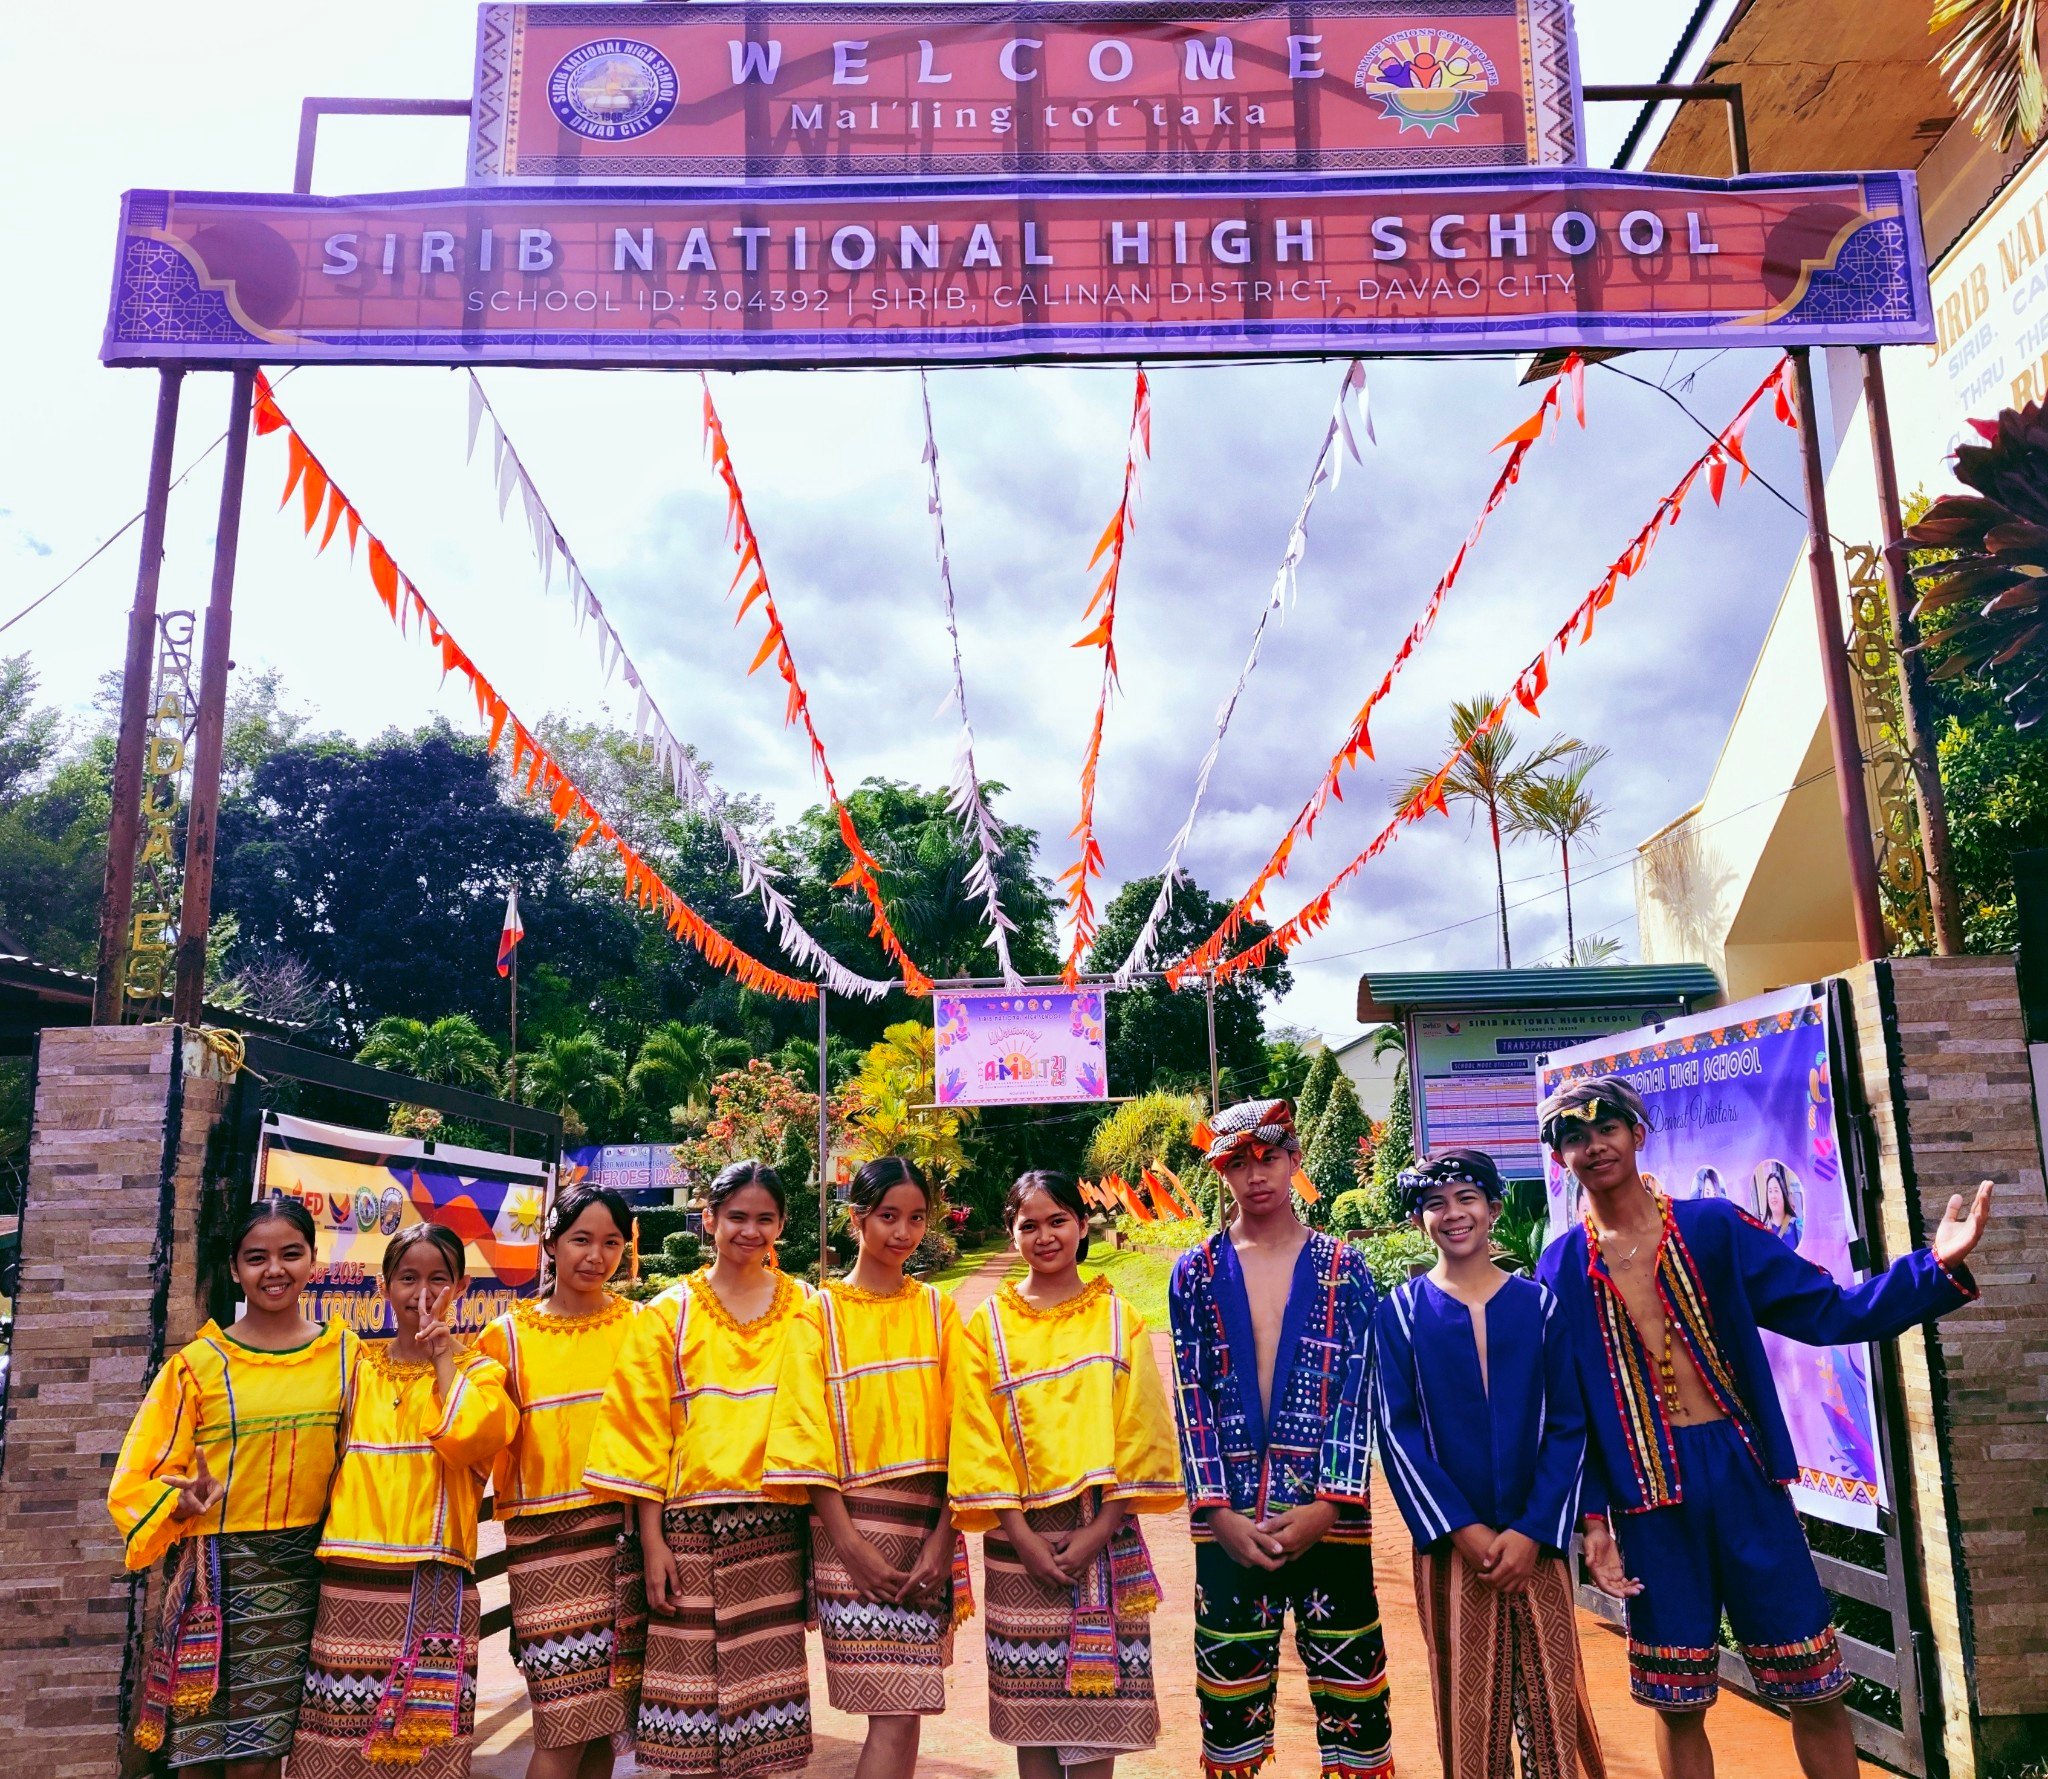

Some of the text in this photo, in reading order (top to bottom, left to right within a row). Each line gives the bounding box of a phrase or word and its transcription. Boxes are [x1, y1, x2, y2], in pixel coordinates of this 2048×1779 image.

[552, 41, 675, 104] SIRIB NATIONAL HIGH SCHOOL
[728, 34, 1325, 85] WELCOME
[1382, 28, 1436, 46] VISIONS
[1437, 29, 1472, 48] COME
[1471, 44, 1487, 61] TO
[1483, 60, 1500, 86] LIFE
[569, 115, 653, 137] DAVAO CITY
[322, 210, 1719, 275] SIRIB NATIONAL HIGH SCHOOL
[1998, 190, 2048, 293] NAT
[467, 273, 1576, 314] SCHOOL ID: 304392 SIRIB, CALINAN DISTRICT, DAVAO CITY
[2013, 264, 2048, 315] CA
[1960, 356, 2005, 411] THRU
[1503, 1018, 1556, 1026] NATIONAL
[1560, 1016, 1586, 1024] HIGH
[1590, 1015, 1632, 1023] SCHOOL
[1502, 1039, 1569, 1051] TRANSPARENCY
[1670, 1060, 1698, 1089] HIGH
[1704, 1047, 1762, 1083] SCHOOL
[1648, 1094, 1739, 1133] Dearest Visitors
[592, 1168, 651, 1186] HEROES
[616, 1160, 645, 1168] NATIONAL
[330, 1260, 366, 1285] 2025
[298, 1290, 385, 1333] ILIPINO
